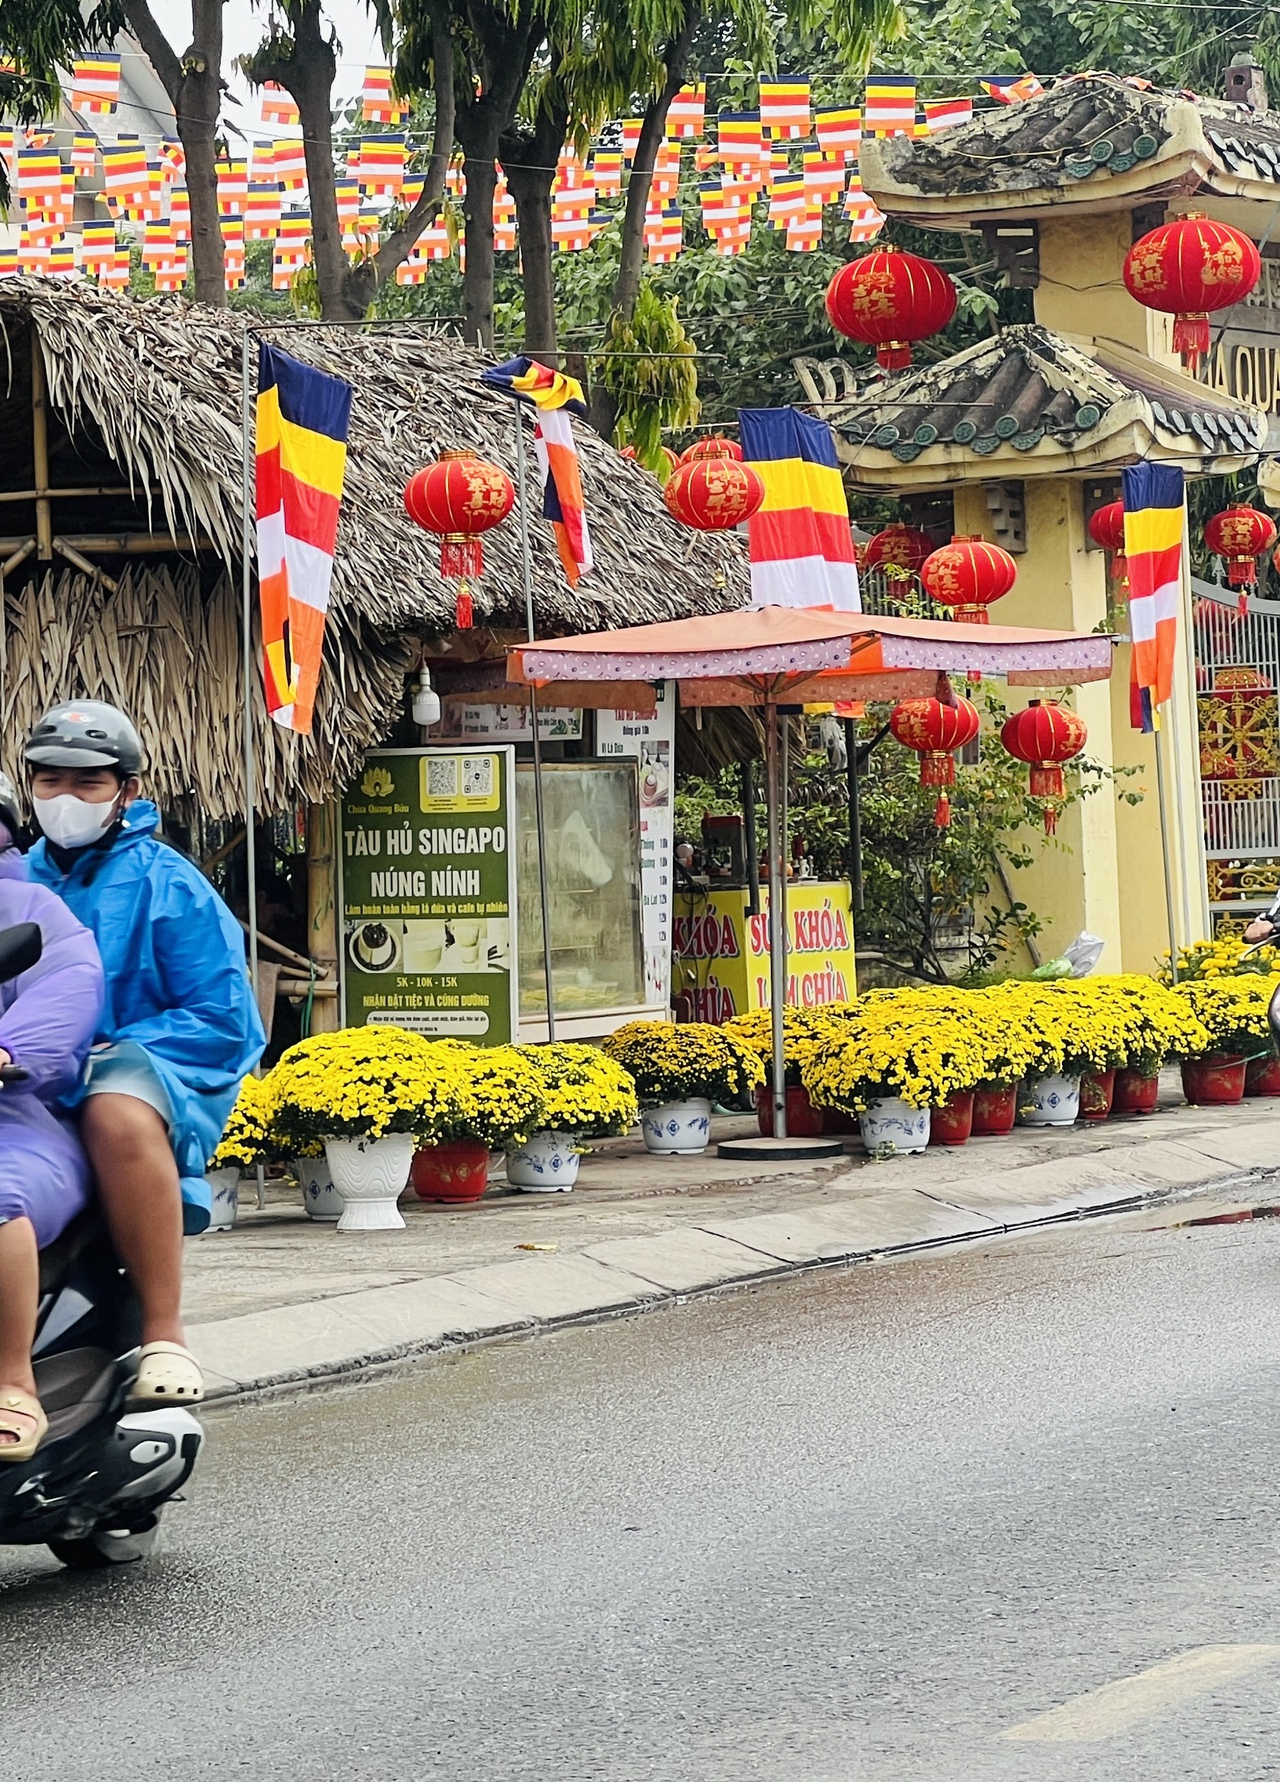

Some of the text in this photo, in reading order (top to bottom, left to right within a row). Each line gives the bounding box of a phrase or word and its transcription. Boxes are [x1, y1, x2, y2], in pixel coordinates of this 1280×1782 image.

[344, 820, 506, 857] TÀU HỦ SINGAPO
[371, 865, 480, 898] NÚNG NÍNH
[446, 902, 457, 914] và
[794, 898, 851, 952] KHÓA
[396, 976, 409, 988] 5K
[416, 976, 433, 988] 10K
[441, 976, 458, 988] 15K
[363, 993, 386, 1009] NHẬN
[405, 993, 423, 1009] TIỆC
[424, 993, 436, 1007] VÀ
[436, 993, 460, 1007] CÚNG
